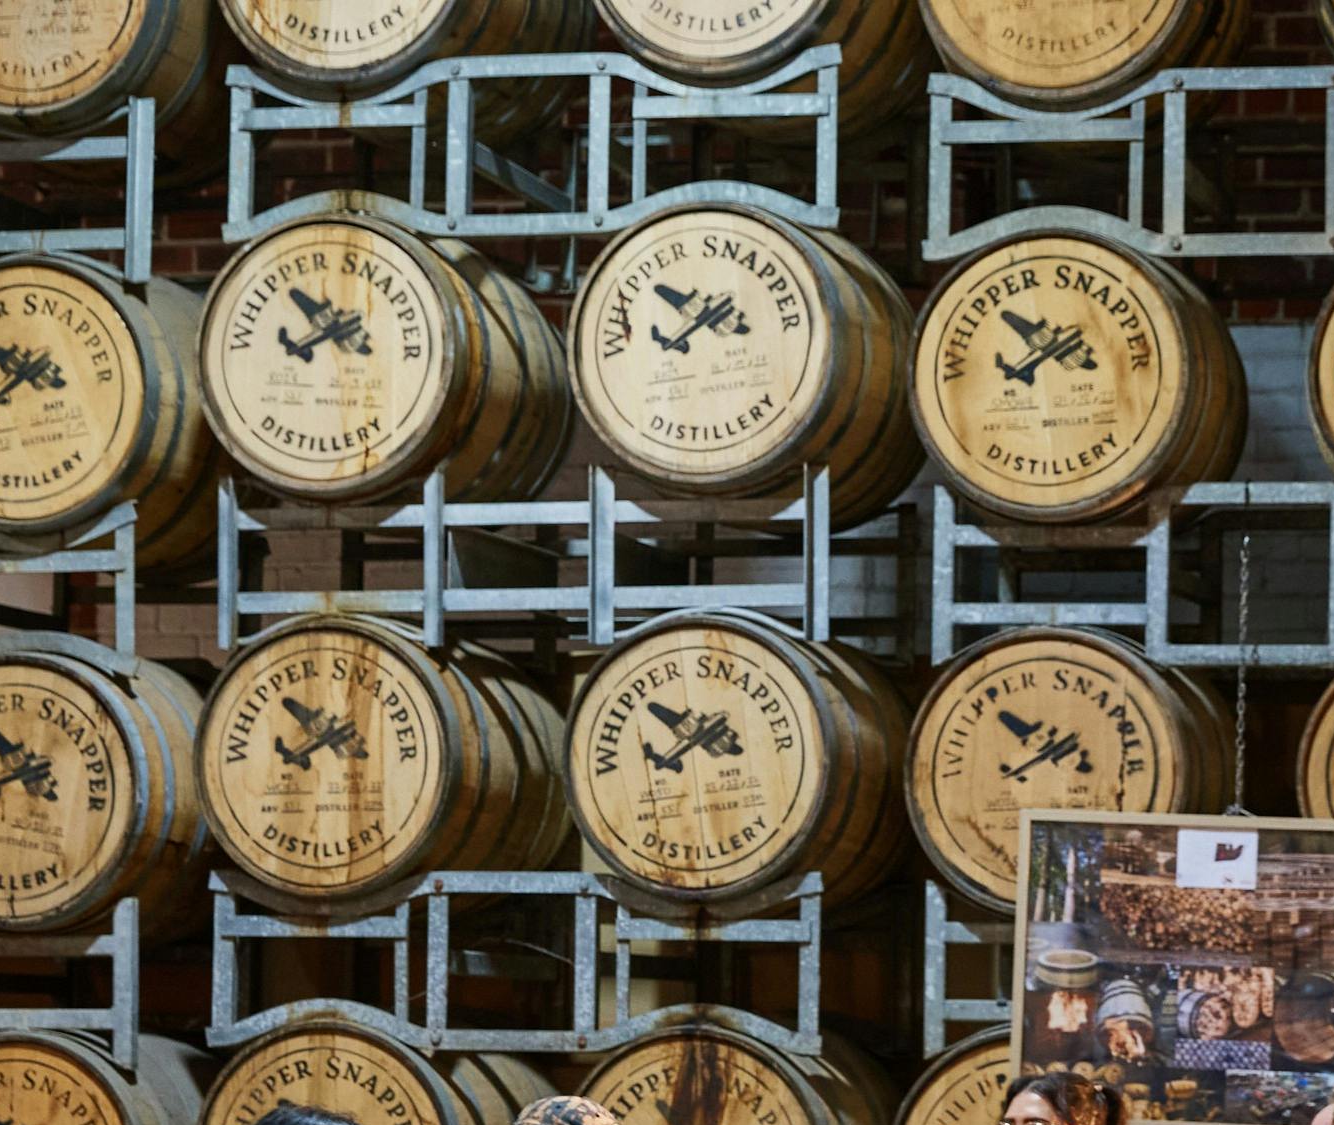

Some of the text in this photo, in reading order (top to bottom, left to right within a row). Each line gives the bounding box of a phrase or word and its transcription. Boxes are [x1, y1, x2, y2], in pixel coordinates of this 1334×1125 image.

[284, 5, 403, 44] DISTILLERY
[1000, 18, 1119, 53] DISTILLERY
[229, 251, 422, 361] WHIPPER SNAPPER
[703, 235, 801, 333] SNAPPER
[23, 293, 113, 384] SNAPPER
[942, 264, 1152, 382] WHIPPER SNAPPER
[261, 415, 381, 452] DISTILLERY
[650, 393, 775, 442] DISTILLERY
[986, 432, 1119, 476] DISTILLERY
[225, 657, 419, 764] WHIPPER SNAPPER
[595, 654, 793, 775] WHIPPER SNAPPER
[38, 696, 107, 812] SNAPPER
[263, 819, 385, 858] DISTILLERY
[644, 815, 768, 861] DISTILLERY
